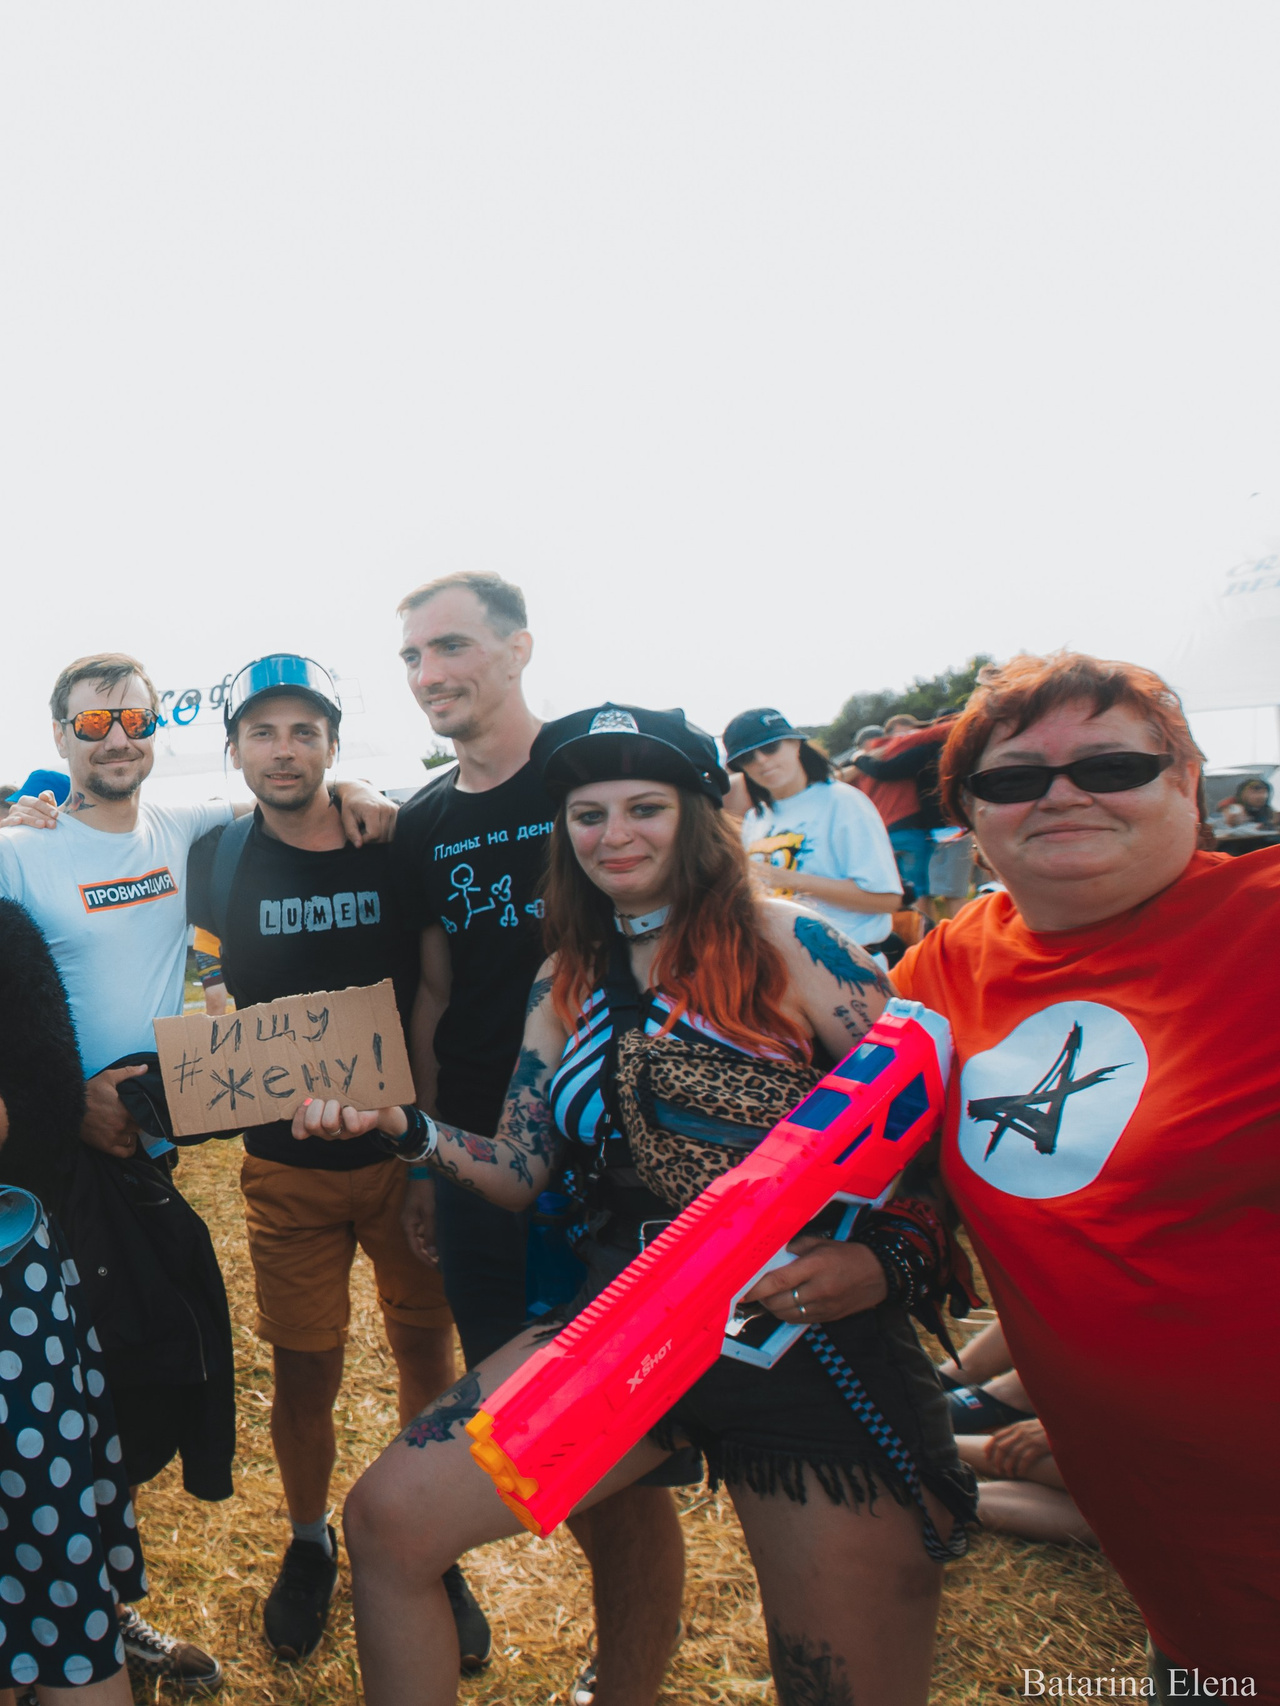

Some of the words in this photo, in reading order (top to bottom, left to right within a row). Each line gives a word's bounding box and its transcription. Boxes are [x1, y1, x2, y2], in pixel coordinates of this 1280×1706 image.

[434, 836, 481, 861] Планы
[487, 830, 509, 845] на
[84, 873, 174, 906] ПРОВИНЦИЯ
[260, 891, 380, 935] LUMEN
